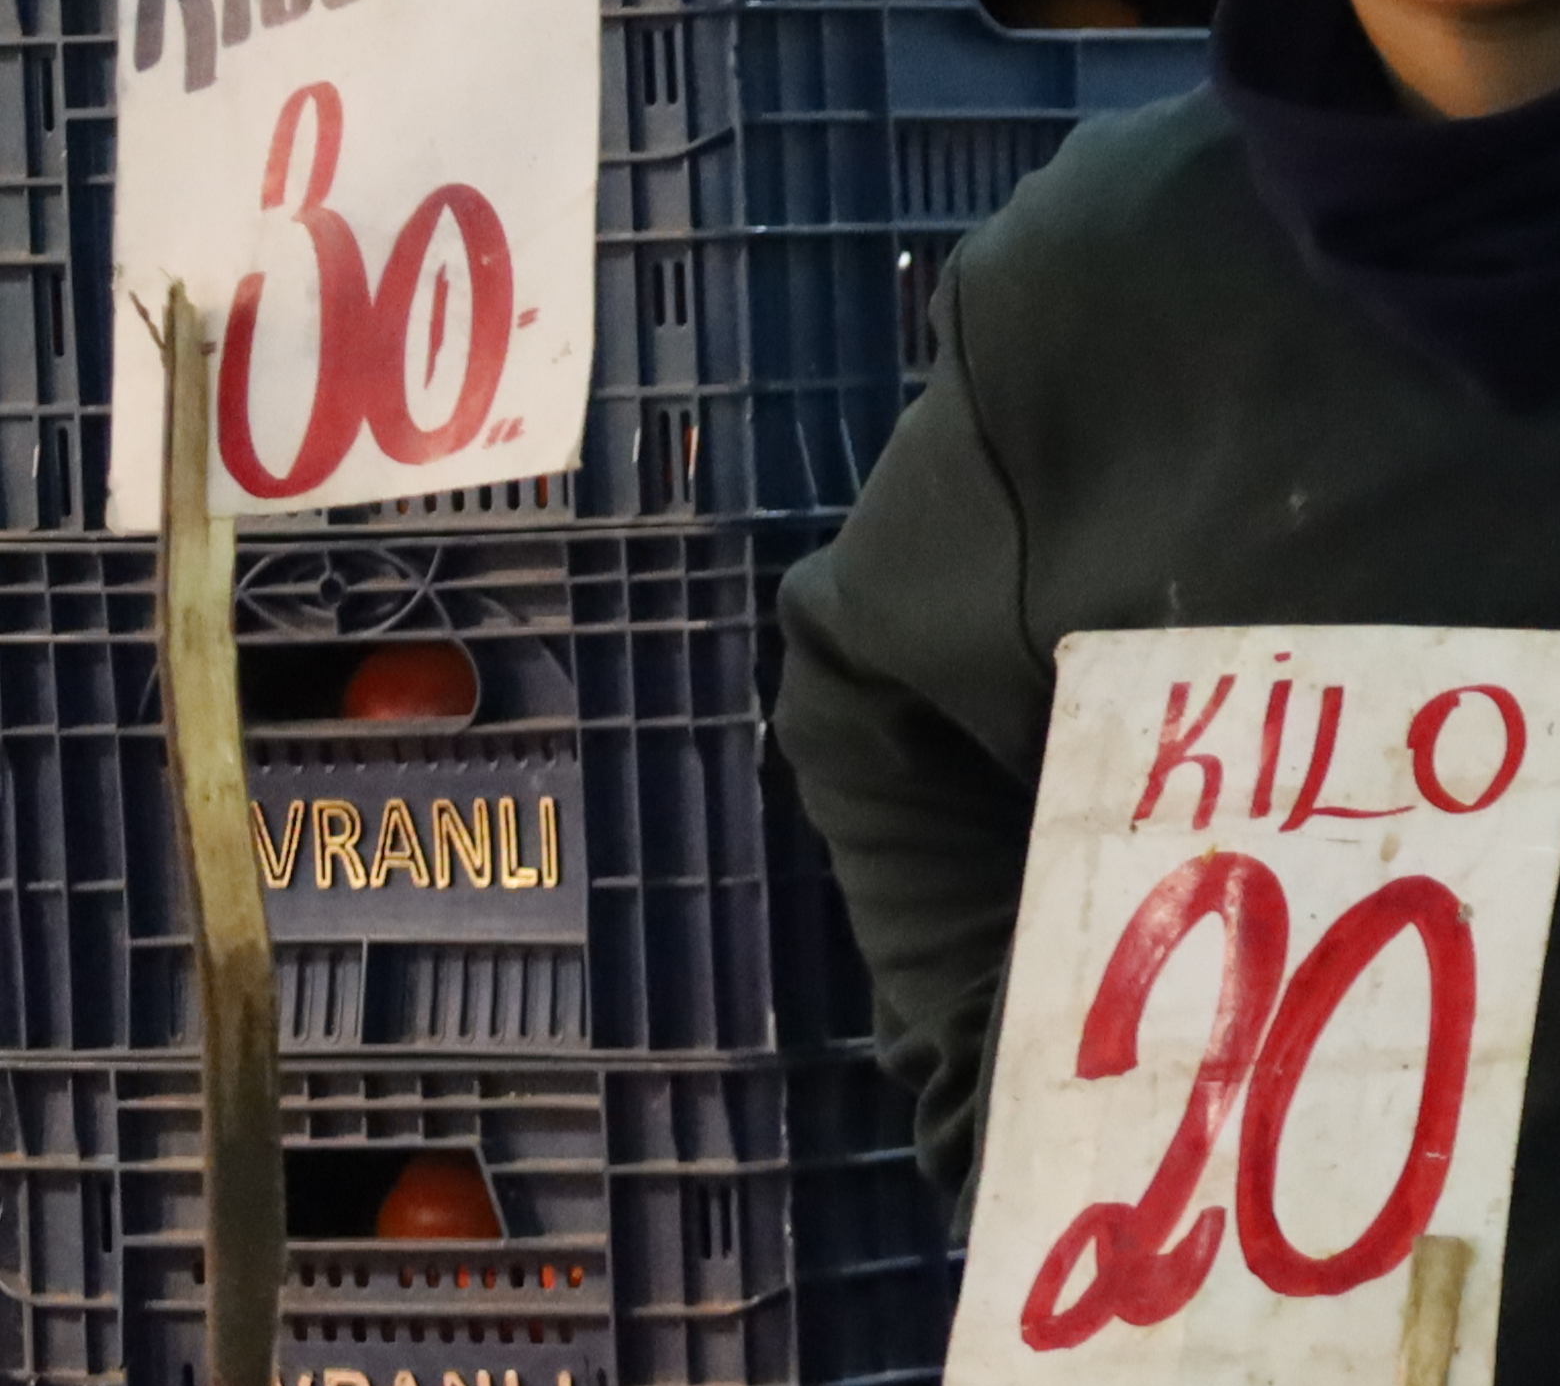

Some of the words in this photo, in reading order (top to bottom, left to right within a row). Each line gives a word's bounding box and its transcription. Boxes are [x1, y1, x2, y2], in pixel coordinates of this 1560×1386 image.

[1131, 650, 1527, 834] KİLO
[250, 794, 560, 890] VRANLI
[1019, 849, 1478, 1352] 20
